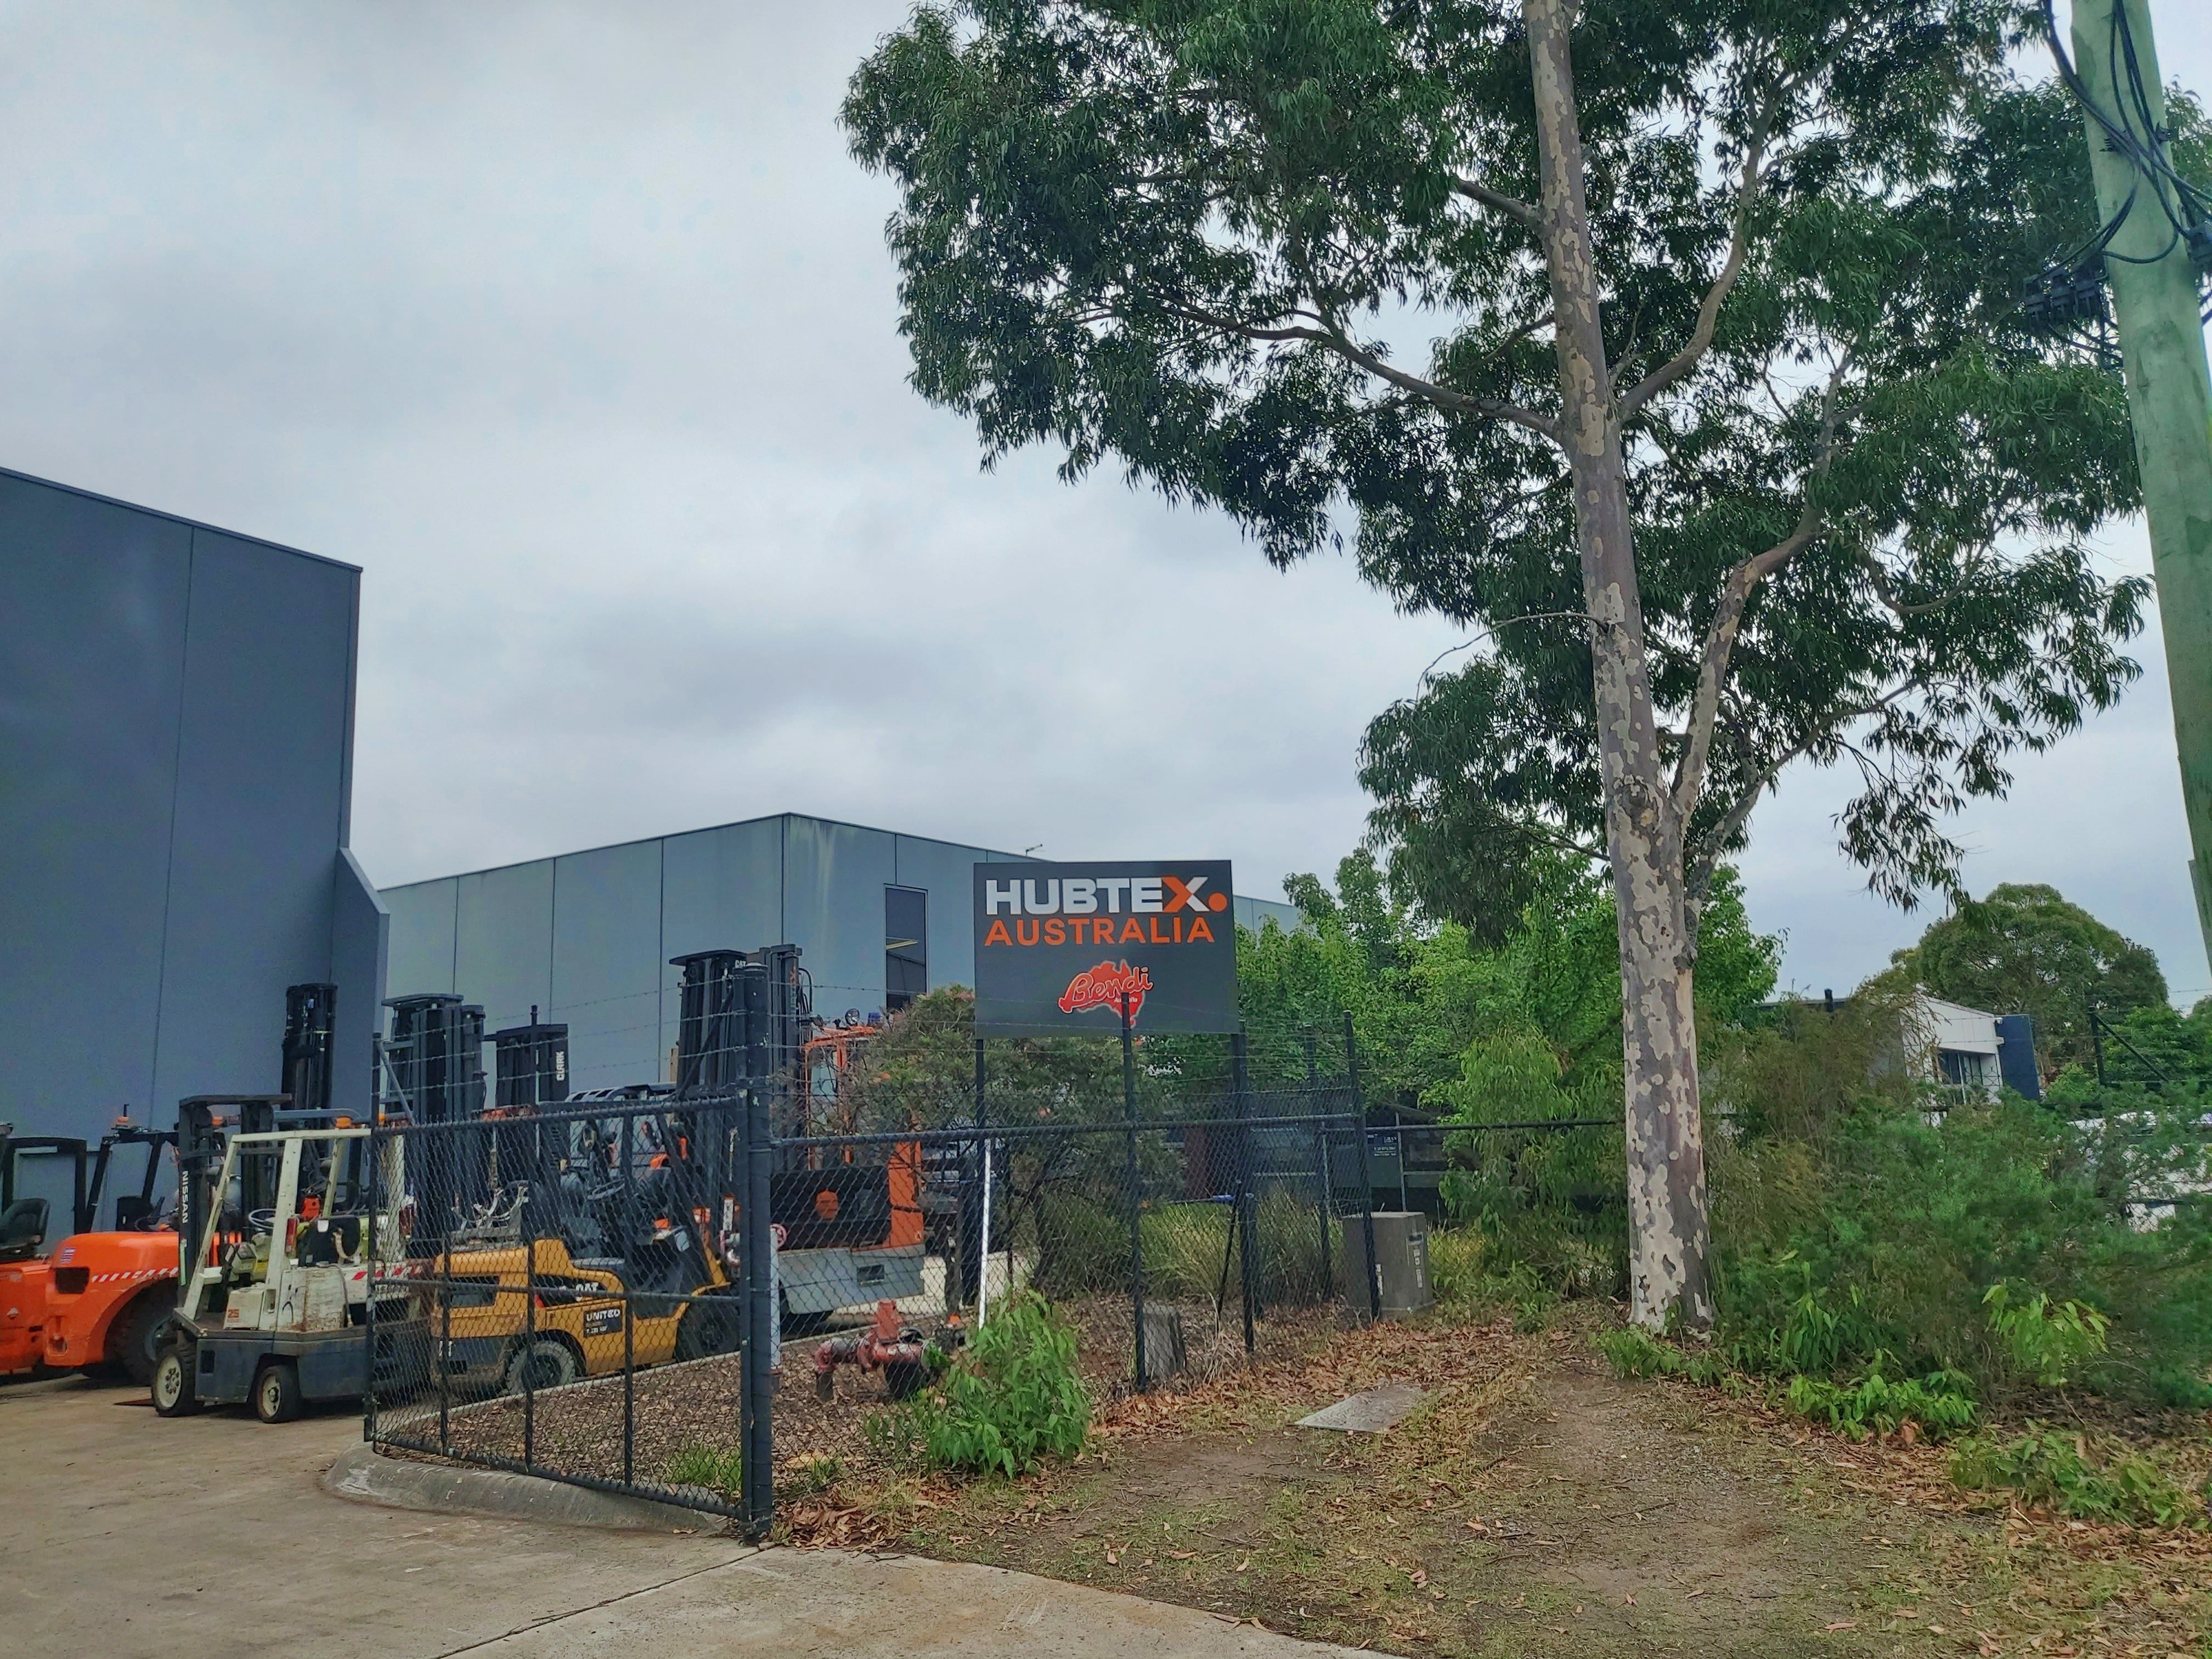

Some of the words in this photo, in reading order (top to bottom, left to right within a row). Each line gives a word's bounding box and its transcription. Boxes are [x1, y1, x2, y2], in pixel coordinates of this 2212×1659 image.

[984, 916, 1215, 946] AUSTRALIA
[735, 960, 747, 968] CAT
[1058, 966, 1154, 1014] Bendi
[556, 1051, 565, 1081] CLARK
[228, 1309, 240, 1318] 25
[586, 1309, 620, 1322] UNITED
